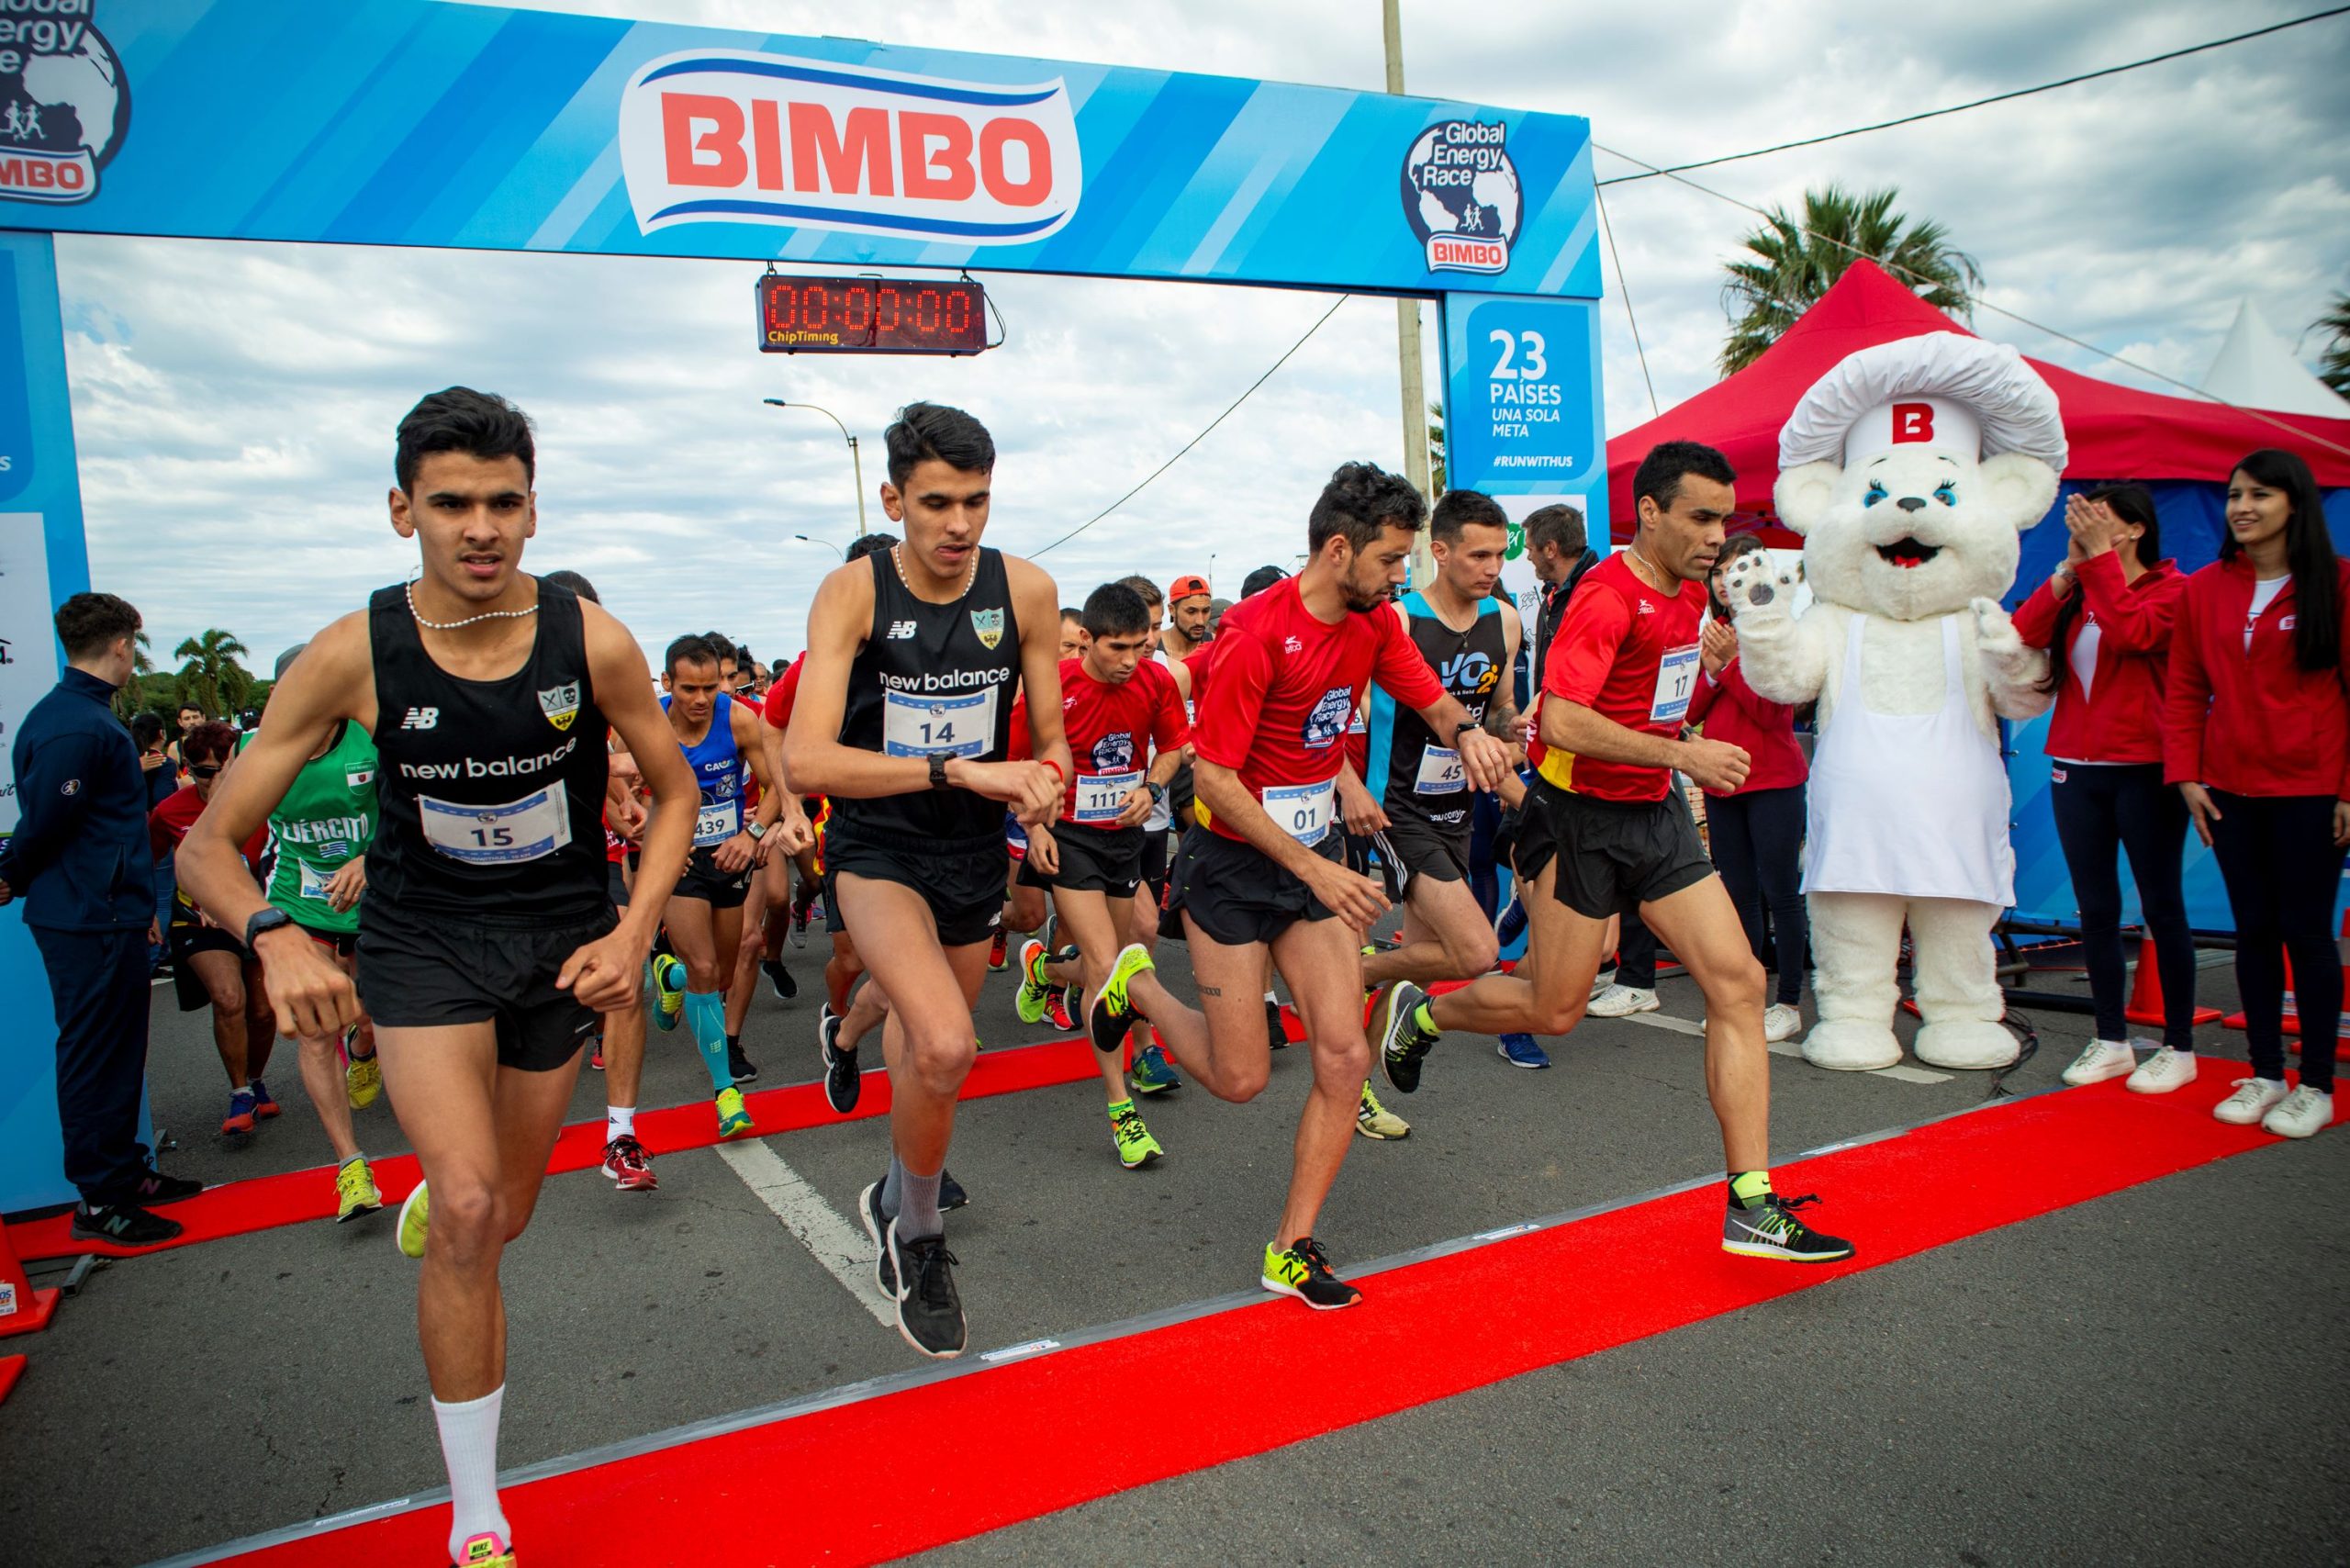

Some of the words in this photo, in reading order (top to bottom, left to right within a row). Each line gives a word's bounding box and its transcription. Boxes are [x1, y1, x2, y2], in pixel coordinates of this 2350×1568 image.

[1446, 123, 1505, 144] Global
[661, 92, 1053, 207] BIMBO
[1434, 144, 1502, 171] Energy
[1423, 165, 1472, 186] Race
[1434, 242, 1502, 264] BIMBO
[771, 286, 969, 332] 00:00:00
[767, 330, 839, 345] ChipTiming
[1489, 329, 1547, 381] 23
[1491, 378, 1561, 405] PAÍSES
[1492, 409, 1522, 421] UNA
[1526, 409, 1560, 422] SOLA
[1892, 402, 1934, 444] B
[1493, 423, 1528, 437] META
[1494, 456, 1572, 467] #RUNWITHUS
[878, 671, 921, 690] new
[924, 666, 1010, 690] balance
[1674, 675, 1688, 698] 17
[1327, 686, 1351, 700] Global
[1321, 698, 1348, 712] Energy
[1315, 711, 1336, 722] Race
[920, 722, 955, 745] 14
[1108, 732, 1131, 742] Global
[400, 763, 460, 779] new
[465, 737, 576, 778] balance
[1441, 765, 1462, 780] 45
[1294, 808, 1315, 831] 01
[471, 827, 514, 847] 15
